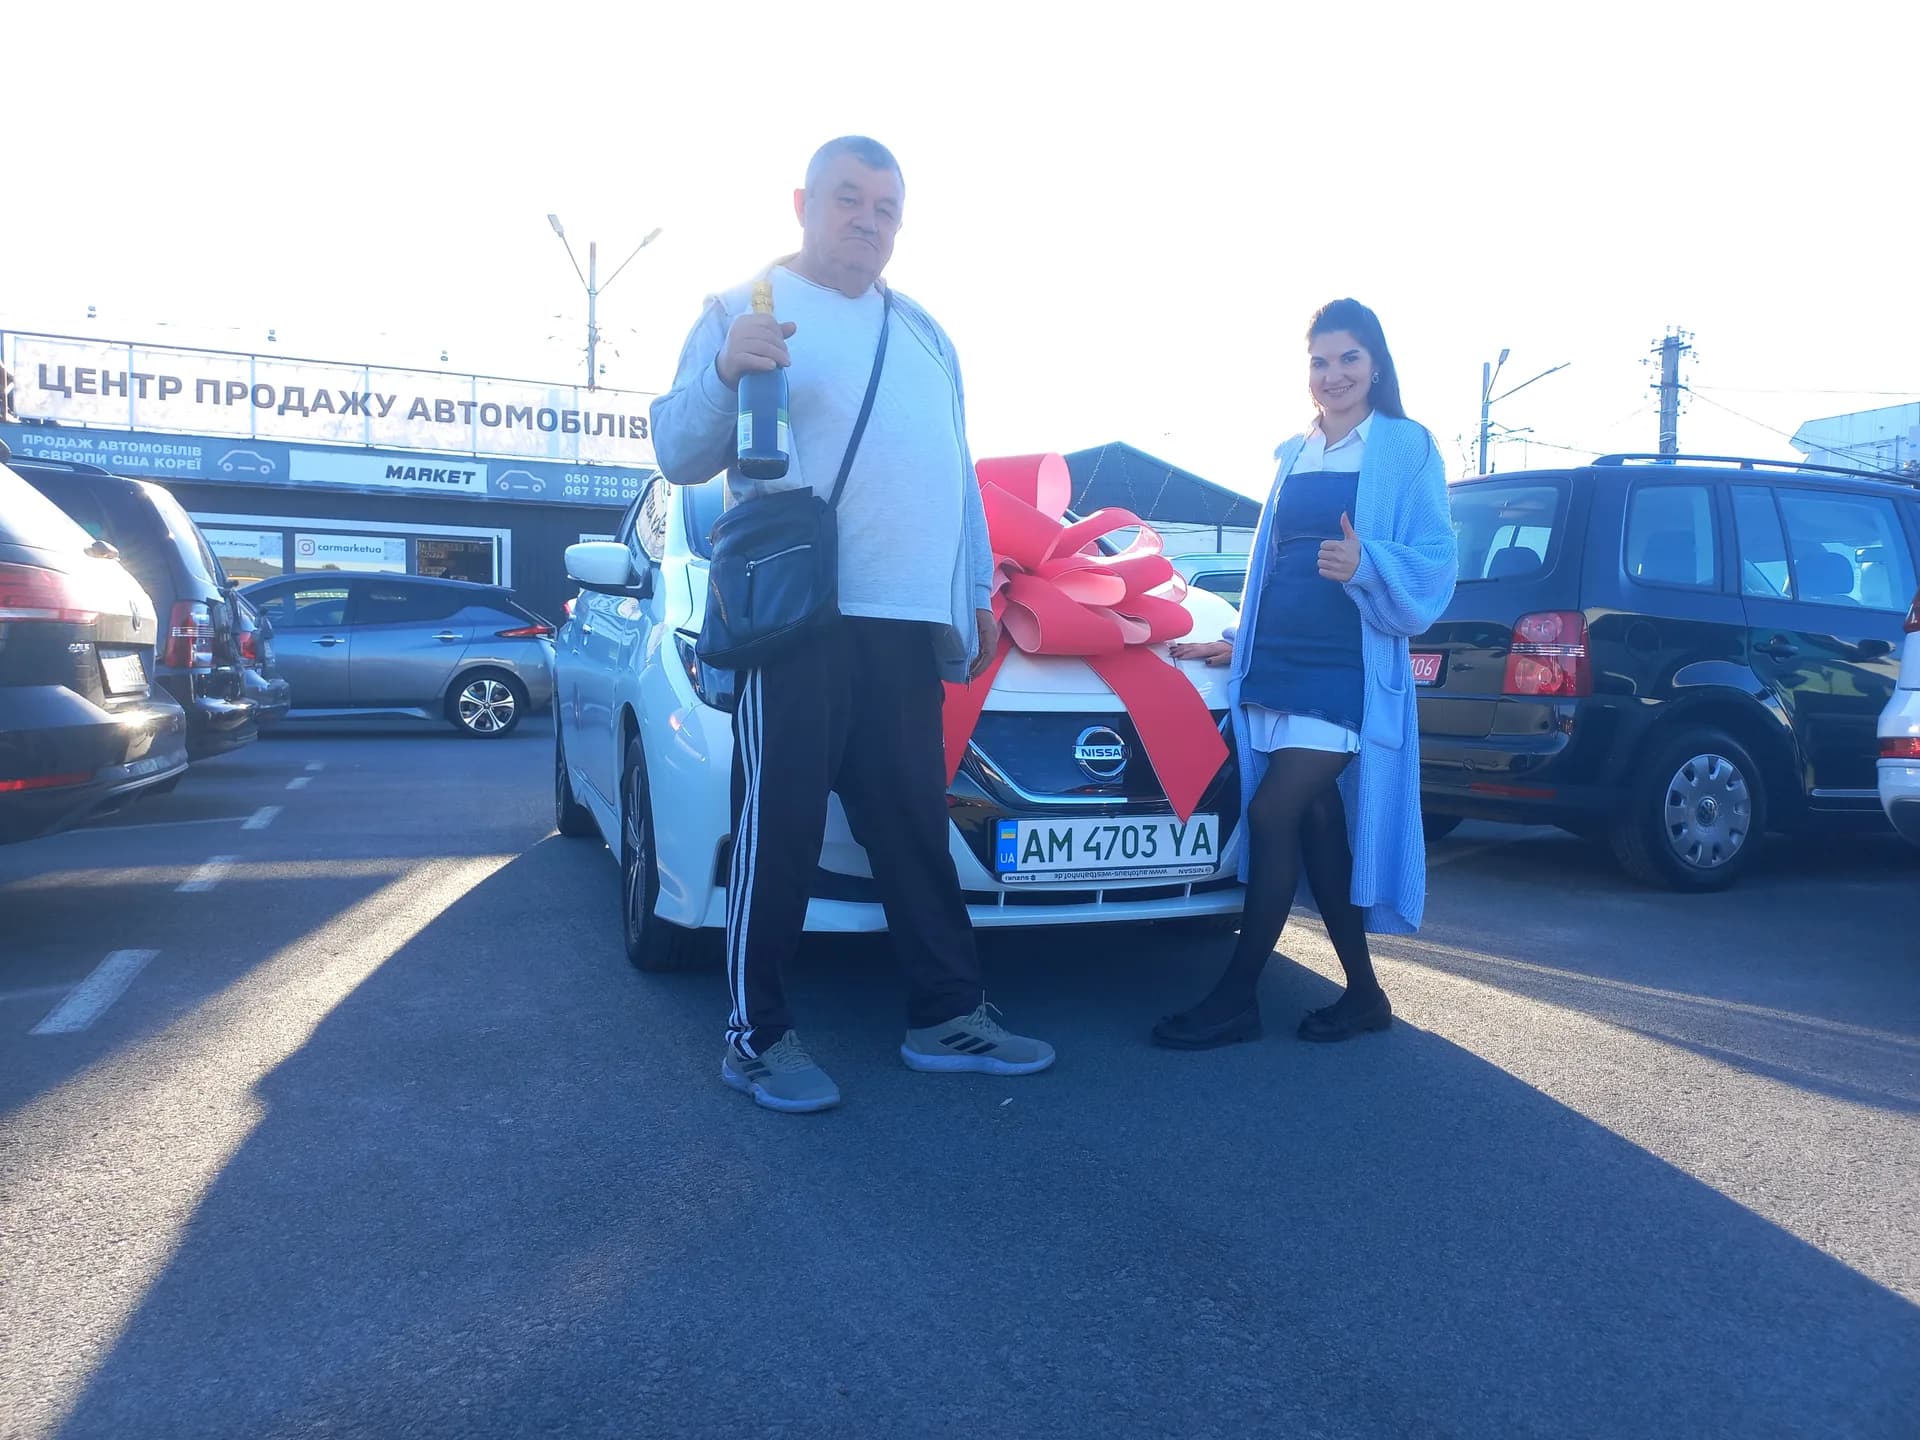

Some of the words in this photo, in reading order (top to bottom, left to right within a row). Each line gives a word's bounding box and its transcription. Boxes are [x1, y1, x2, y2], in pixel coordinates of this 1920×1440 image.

[38, 363, 183, 400] ЦЕНТР
[195, 377, 397, 418] ПРОДАЖУ
[407, 396, 648, 440] АВТОМОБІЛІВ
[22, 434, 93, 449] ПРОДАЖ
[98, 440, 202, 456] АВТОМОБІЛІВ
[39, 450, 107, 465] ЄВРОПИ
[112, 455, 149, 467] США
[154, 457, 202, 471] КОРЕЇ
[385, 464, 476, 485] MARKET
[564, 473, 590, 484] 050
[593, 475, 618, 486] 730
[621, 477, 638, 487] 08
[564, 486, 590, 497] 067
[593, 487, 618, 498] 730
[1021, 827, 1073, 864] AM
[1083, 824, 1158, 861] 4703
[1169, 822, 1212, 857] YA
[1000, 853, 1015, 864] UA
